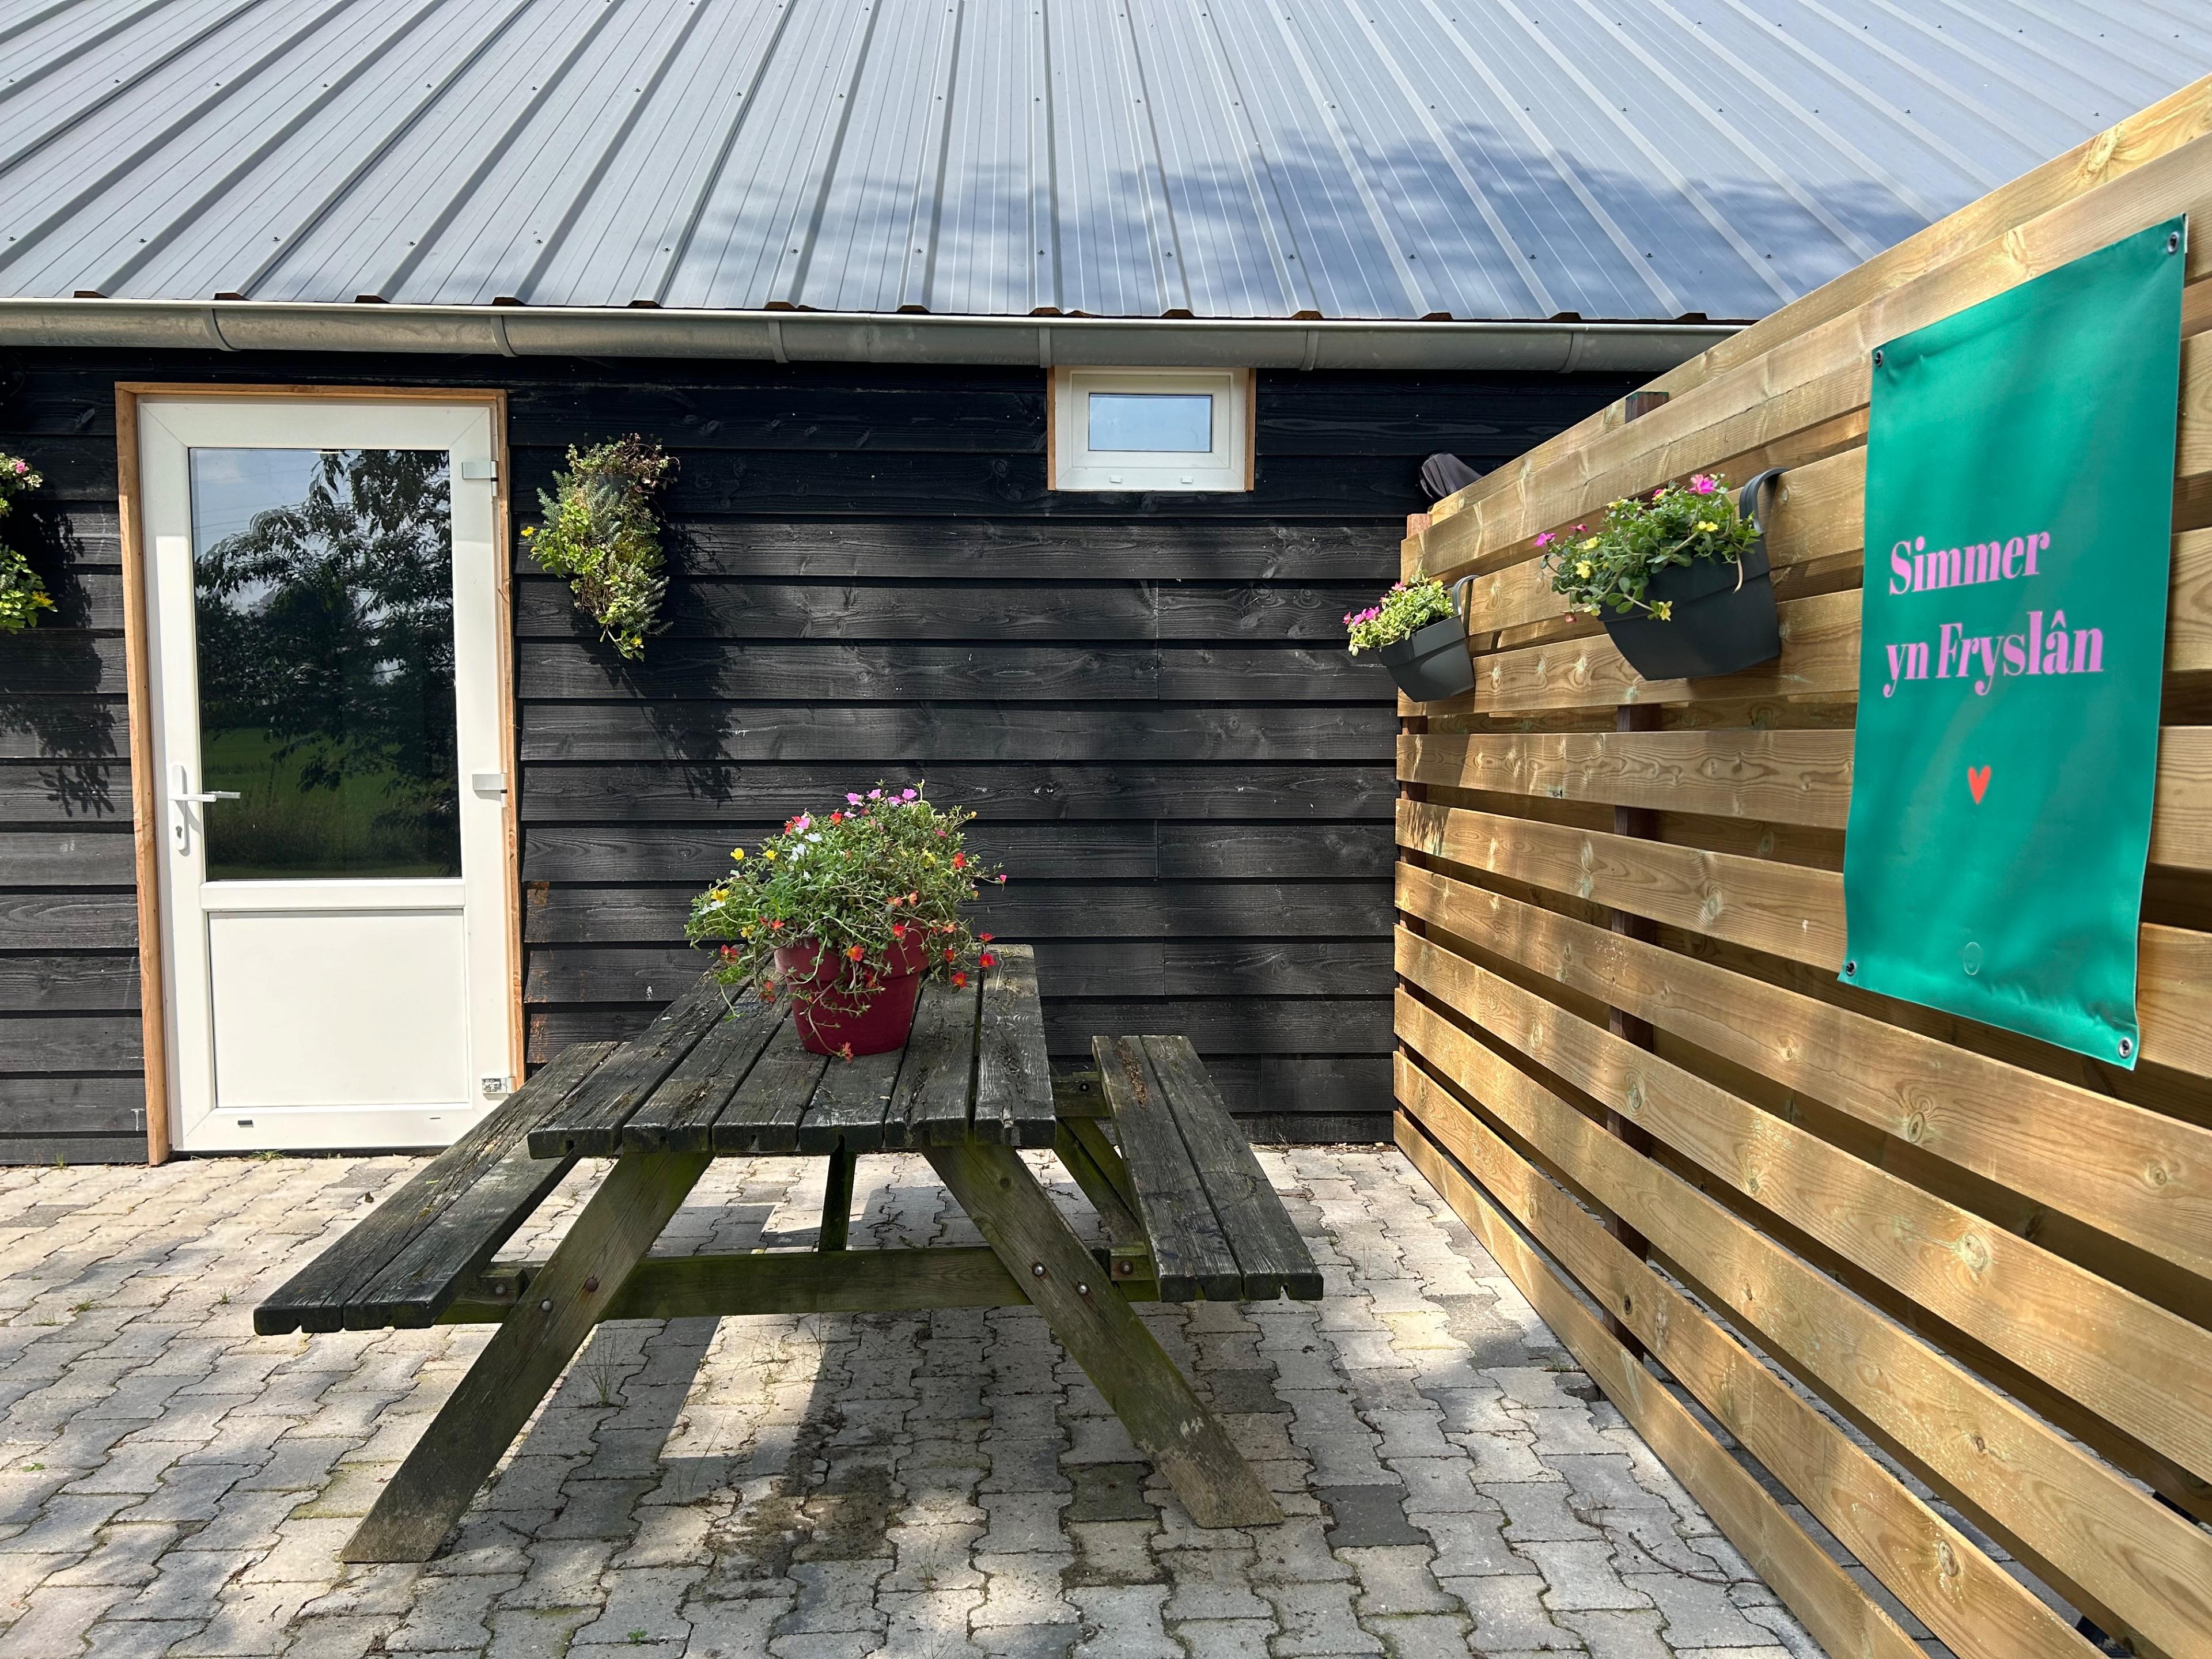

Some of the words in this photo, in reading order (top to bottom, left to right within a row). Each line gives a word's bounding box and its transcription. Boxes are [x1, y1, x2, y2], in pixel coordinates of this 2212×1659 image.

[1889, 532, 2050, 595] Simmer
[1883, 642, 1929, 698] yn
[1936, 610, 2104, 696] Fryslân
